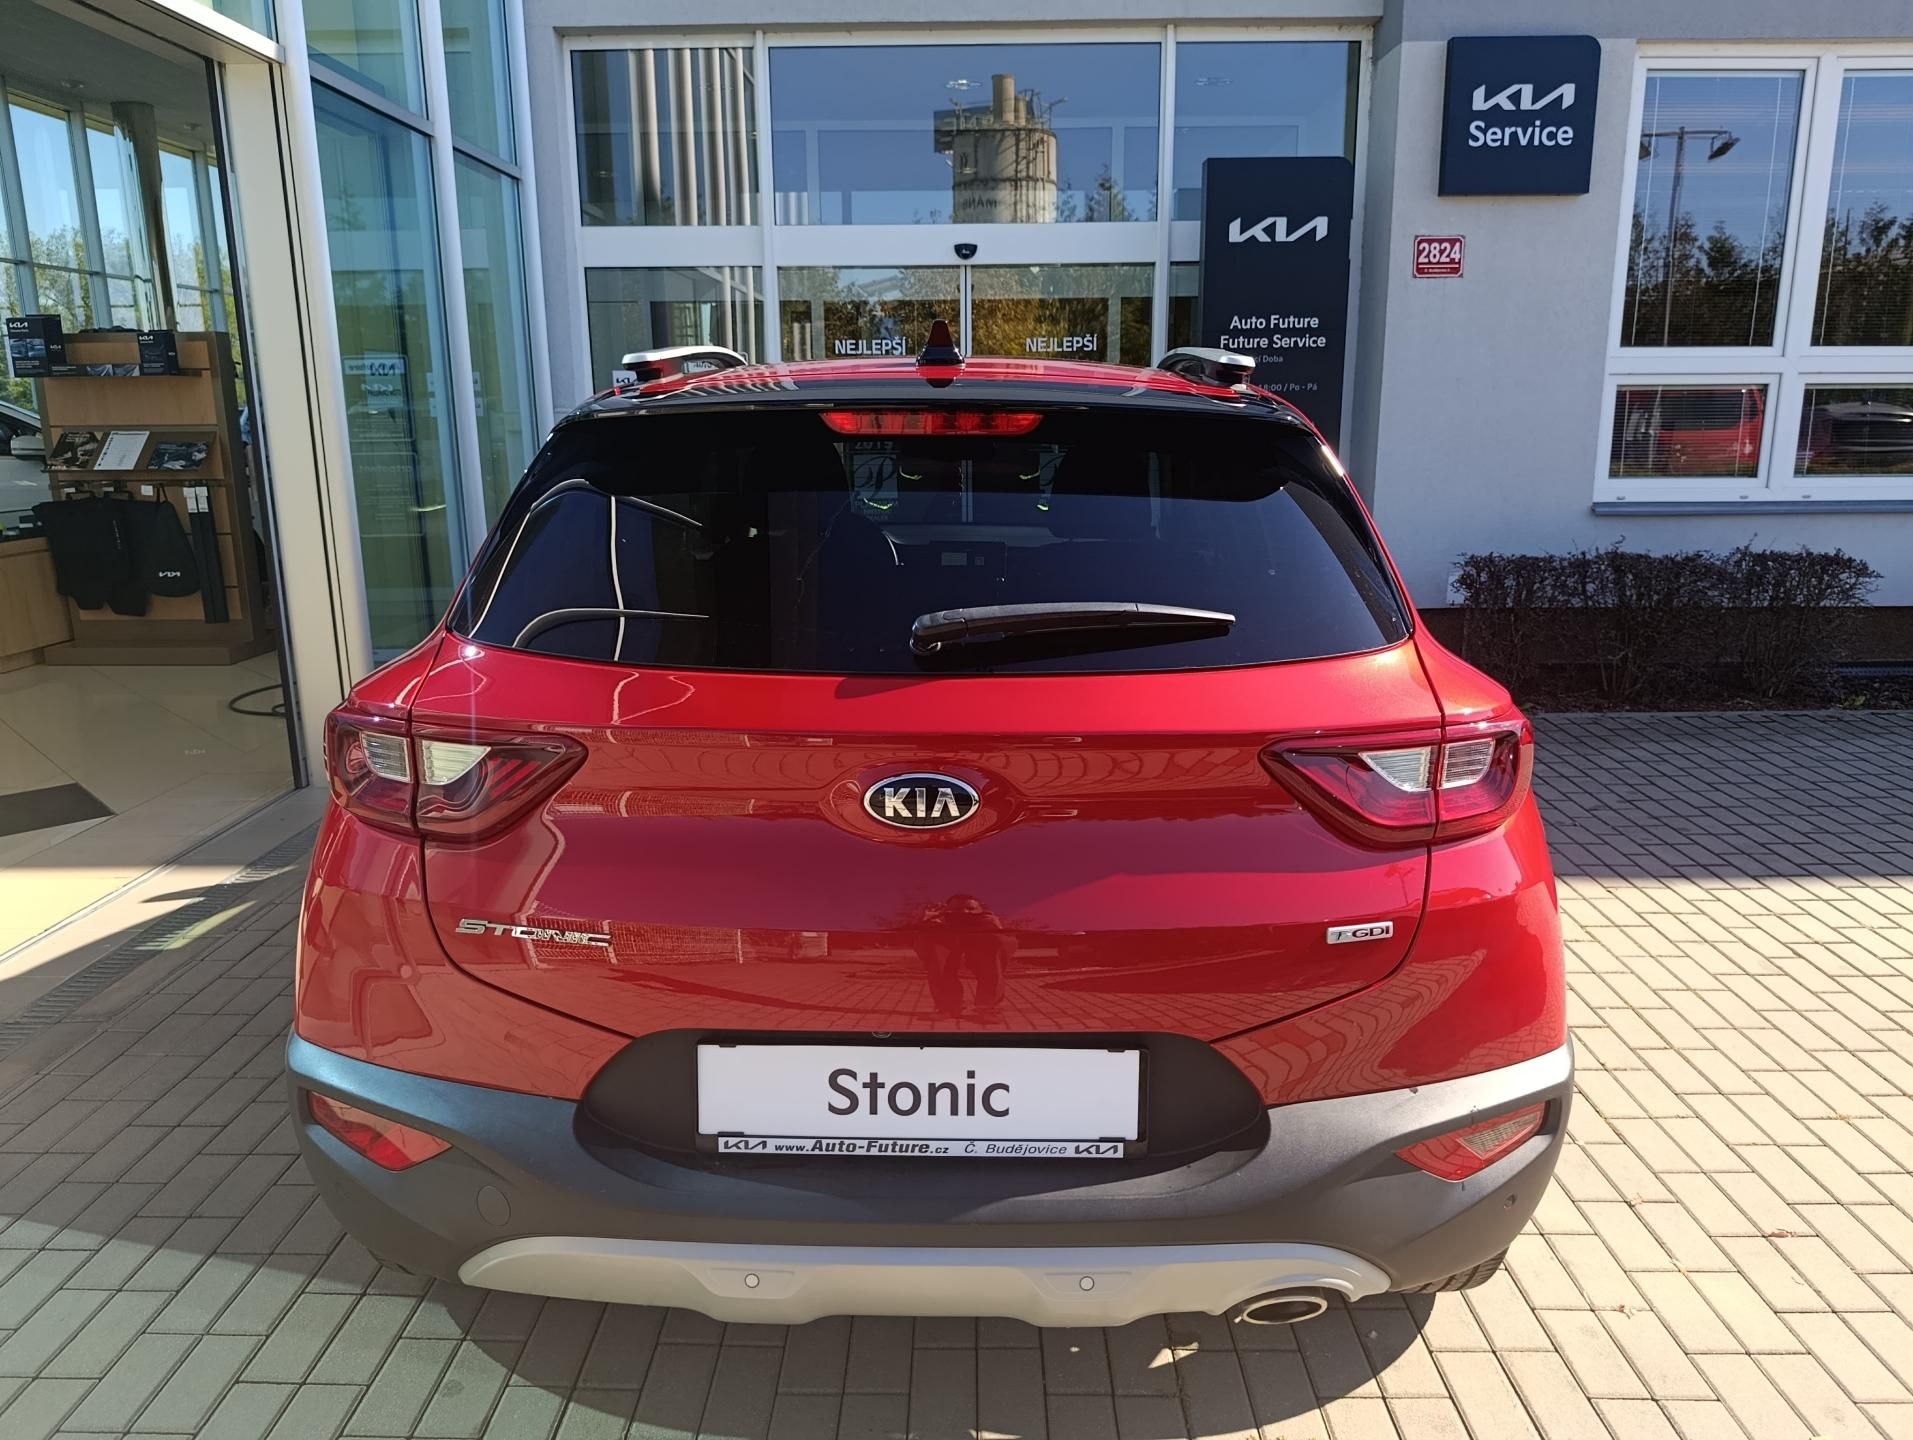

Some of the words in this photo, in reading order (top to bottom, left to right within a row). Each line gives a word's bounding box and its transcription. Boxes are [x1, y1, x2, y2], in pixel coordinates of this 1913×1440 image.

[1472, 83, 1576, 111] KIA
[1468, 120, 1574, 147] Service
[1228, 216, 1328, 243] KIA
[1417, 241, 1461, 263] 2824
[1230, 315, 1266, 330] Auto
[1270, 315, 1320, 329] Future
[834, 337, 906, 356] NEJLEPŠÍ
[1024, 334, 1098, 353] NEJLEPŠÍ
[1220, 335, 1269, 349] Future
[1272, 333, 1327, 348] Service
[1262, 355, 1284, 363] Doba
[884, 788, 960, 818] KIA
[456, 918, 612, 947] STONIC
[828, 1068, 1010, 1118] Stonic
[724, 1140, 767, 1150] KIA
[774, 1140, 949, 1154] www.Auto-Future.cz
[964, 1142, 978, 1154] Č.
[985, 1144, 1067, 1156] Budějovice
[1075, 1144, 1118, 1155] KIA
